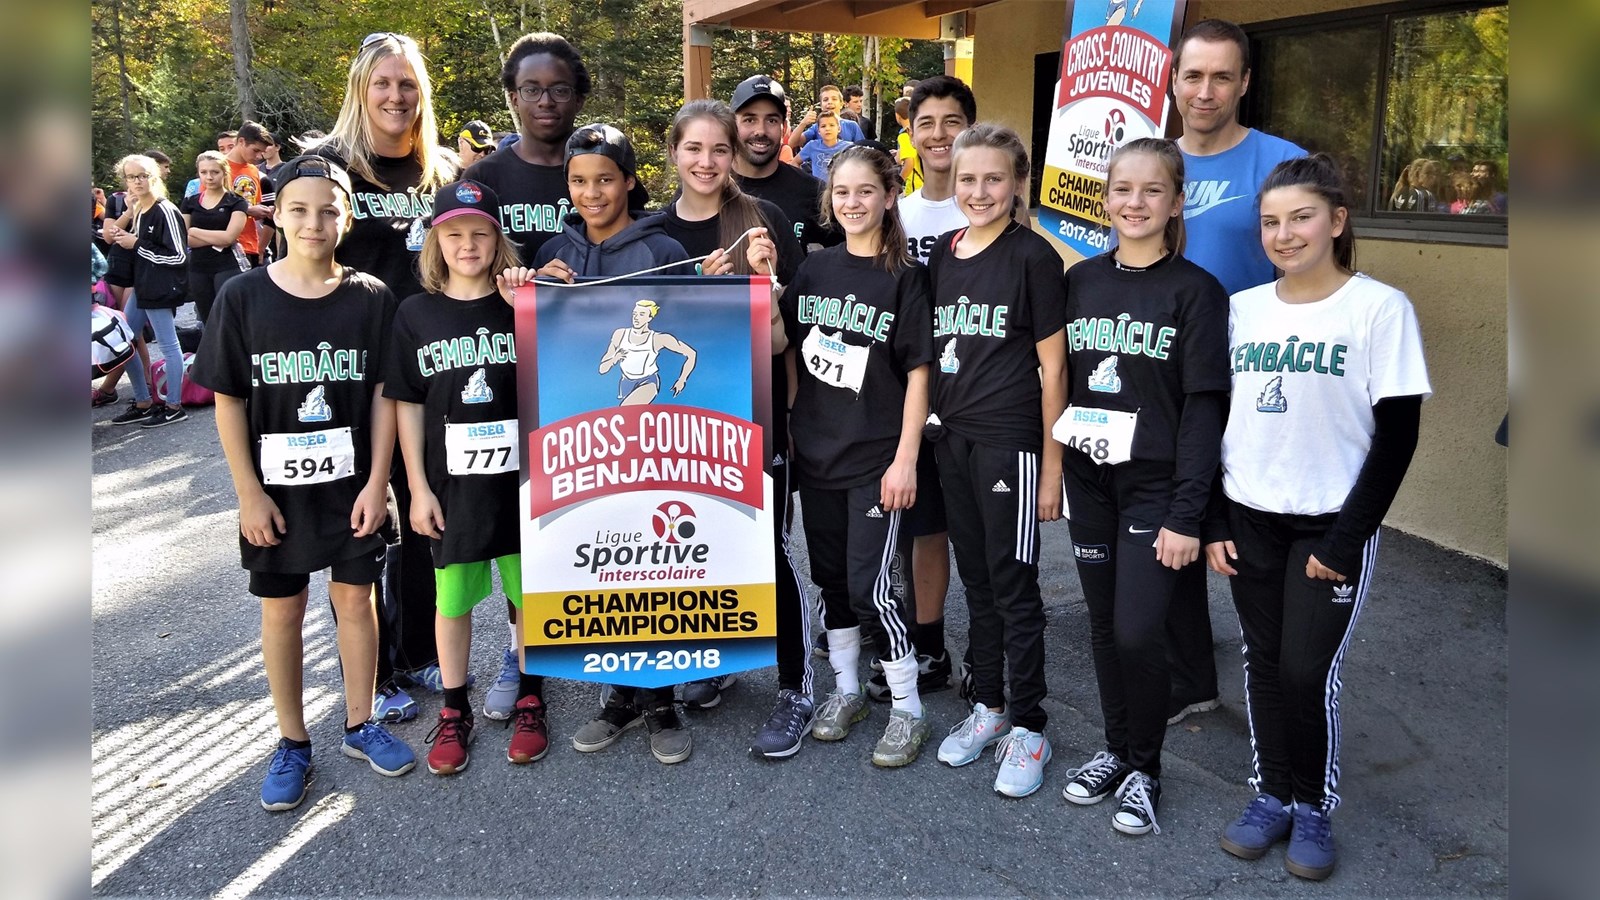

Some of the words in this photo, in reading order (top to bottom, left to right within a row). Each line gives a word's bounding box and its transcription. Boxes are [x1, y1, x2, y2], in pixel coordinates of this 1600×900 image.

[1067, 31, 1167, 88] CROSS-COUNTRY
[1070, 66, 1152, 109] JUVÉNILES
[1079, 125, 1100, 140] Ligue
[1058, 172, 1106, 200] CHAMPI
[1183, 180, 1231, 207] UN
[351, 186, 434, 220] L'EMBÂC
[499, 198, 578, 234] L'EMBÂ
[1059, 219, 1108, 251] 2017-201
[417, 327, 517, 378] L'EMBÂCL
[810, 354, 844, 382] 471
[467, 423, 506, 438] RSEQ
[1072, 410, 1108, 424] RSEQ
[286, 433, 328, 448] RSEQ
[542, 411, 752, 475] CROSS-COUNTRY
[284, 456, 336, 479] 594
[464, 446, 512, 469] 777
[551, 457, 744, 501] BENJAMINS
[596, 530, 643, 547] Ligue
[573, 541, 709, 574] Sportive
[598, 565, 706, 583] interscolaire
[562, 588, 739, 616] CHAMPIONS
[543, 610, 758, 640] CHAMPIONNES
[583, 648, 721, 673] 2017-2018
